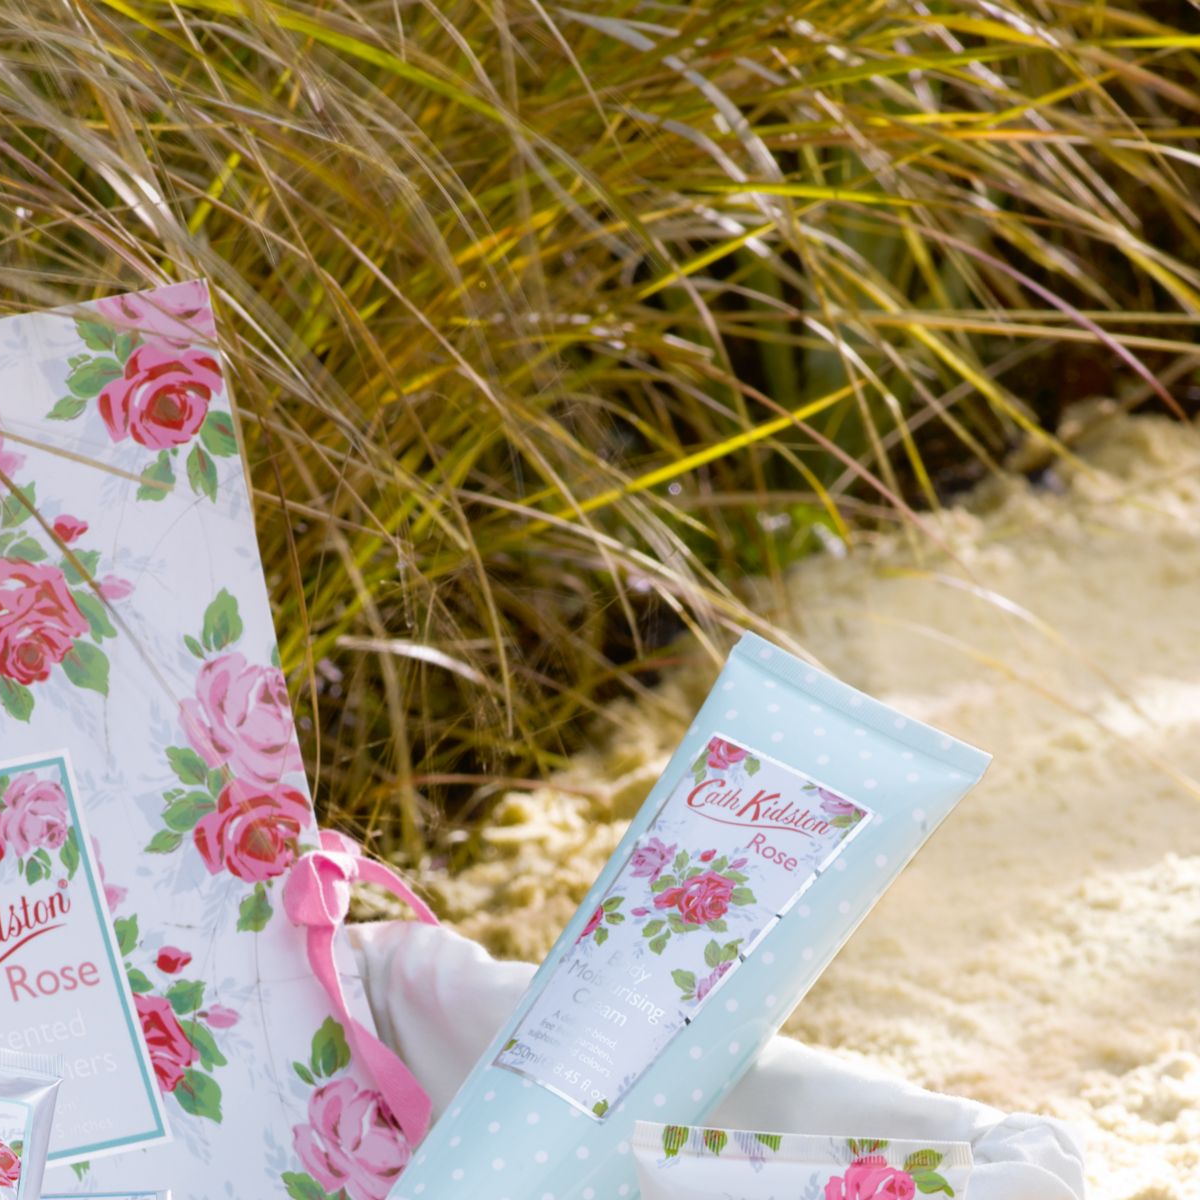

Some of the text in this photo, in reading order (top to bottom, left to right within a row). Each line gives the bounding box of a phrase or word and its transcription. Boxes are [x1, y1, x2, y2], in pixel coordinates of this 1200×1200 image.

[687, 778, 830, 837] Cath Kidston
[747, 833, 799, 872] Rose
[5, 961, 100, 1002] Rose
